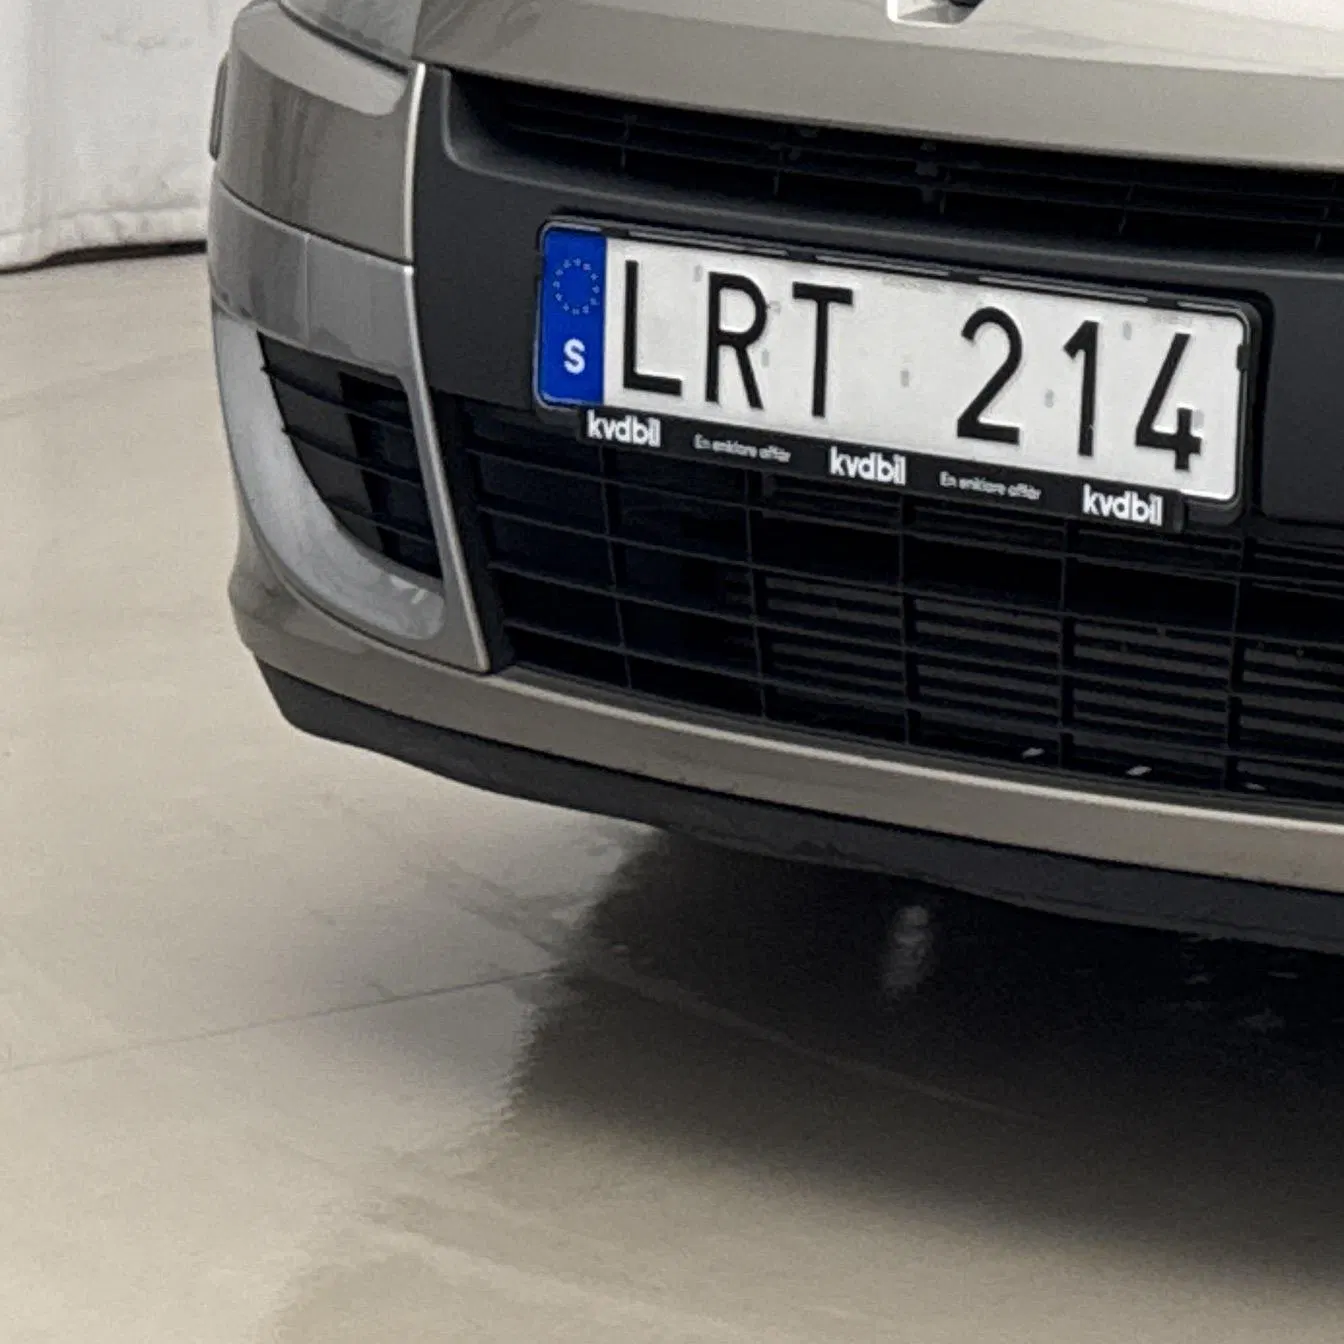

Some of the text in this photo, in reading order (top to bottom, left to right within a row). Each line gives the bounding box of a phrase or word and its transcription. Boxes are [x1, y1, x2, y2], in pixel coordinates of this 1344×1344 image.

[564, 339, 585, 375] S
[622, 259, 1203, 472] LRT 214
[586, 410, 661, 448] kvdbil
[829, 446, 906, 486] kvdbil
[1082, 484, 1163, 526] kvdbil
